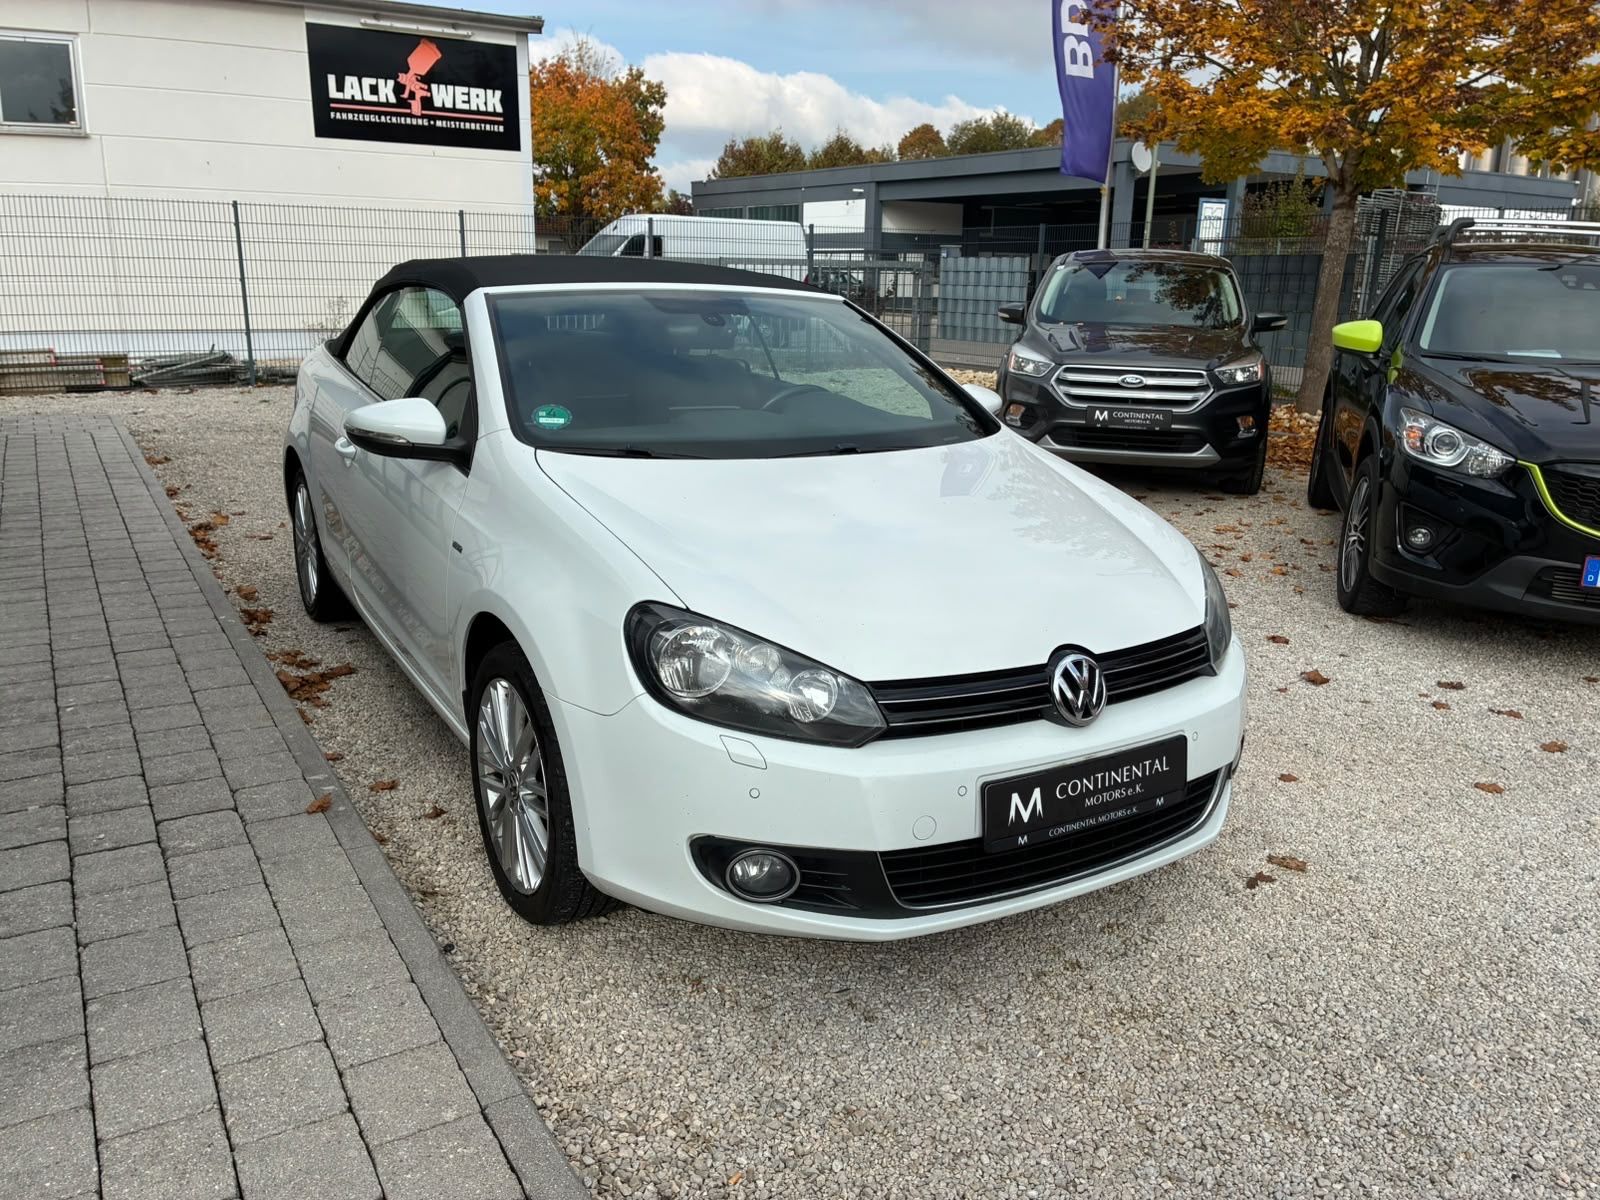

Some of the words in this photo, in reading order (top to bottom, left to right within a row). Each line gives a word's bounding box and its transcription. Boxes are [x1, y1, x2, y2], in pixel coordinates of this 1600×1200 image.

[327, 74, 397, 103] LACK
[430, 83, 503, 113] WERK
[330, 111, 429, 125] FAHRZEUGLACKIERUNG
[435, 120, 504, 132] MEISTERBETRIEB
[1112, 411, 1165, 421] CONTINENTAL
[1008, 787, 1043, 826] M
[1055, 756, 1170, 799] CONTINENTAL
[1084, 787, 1126, 808] MOTORS
[1048, 819, 1097, 837] CONTINENTAL
[1097, 808, 1127, 825] MOTORS
